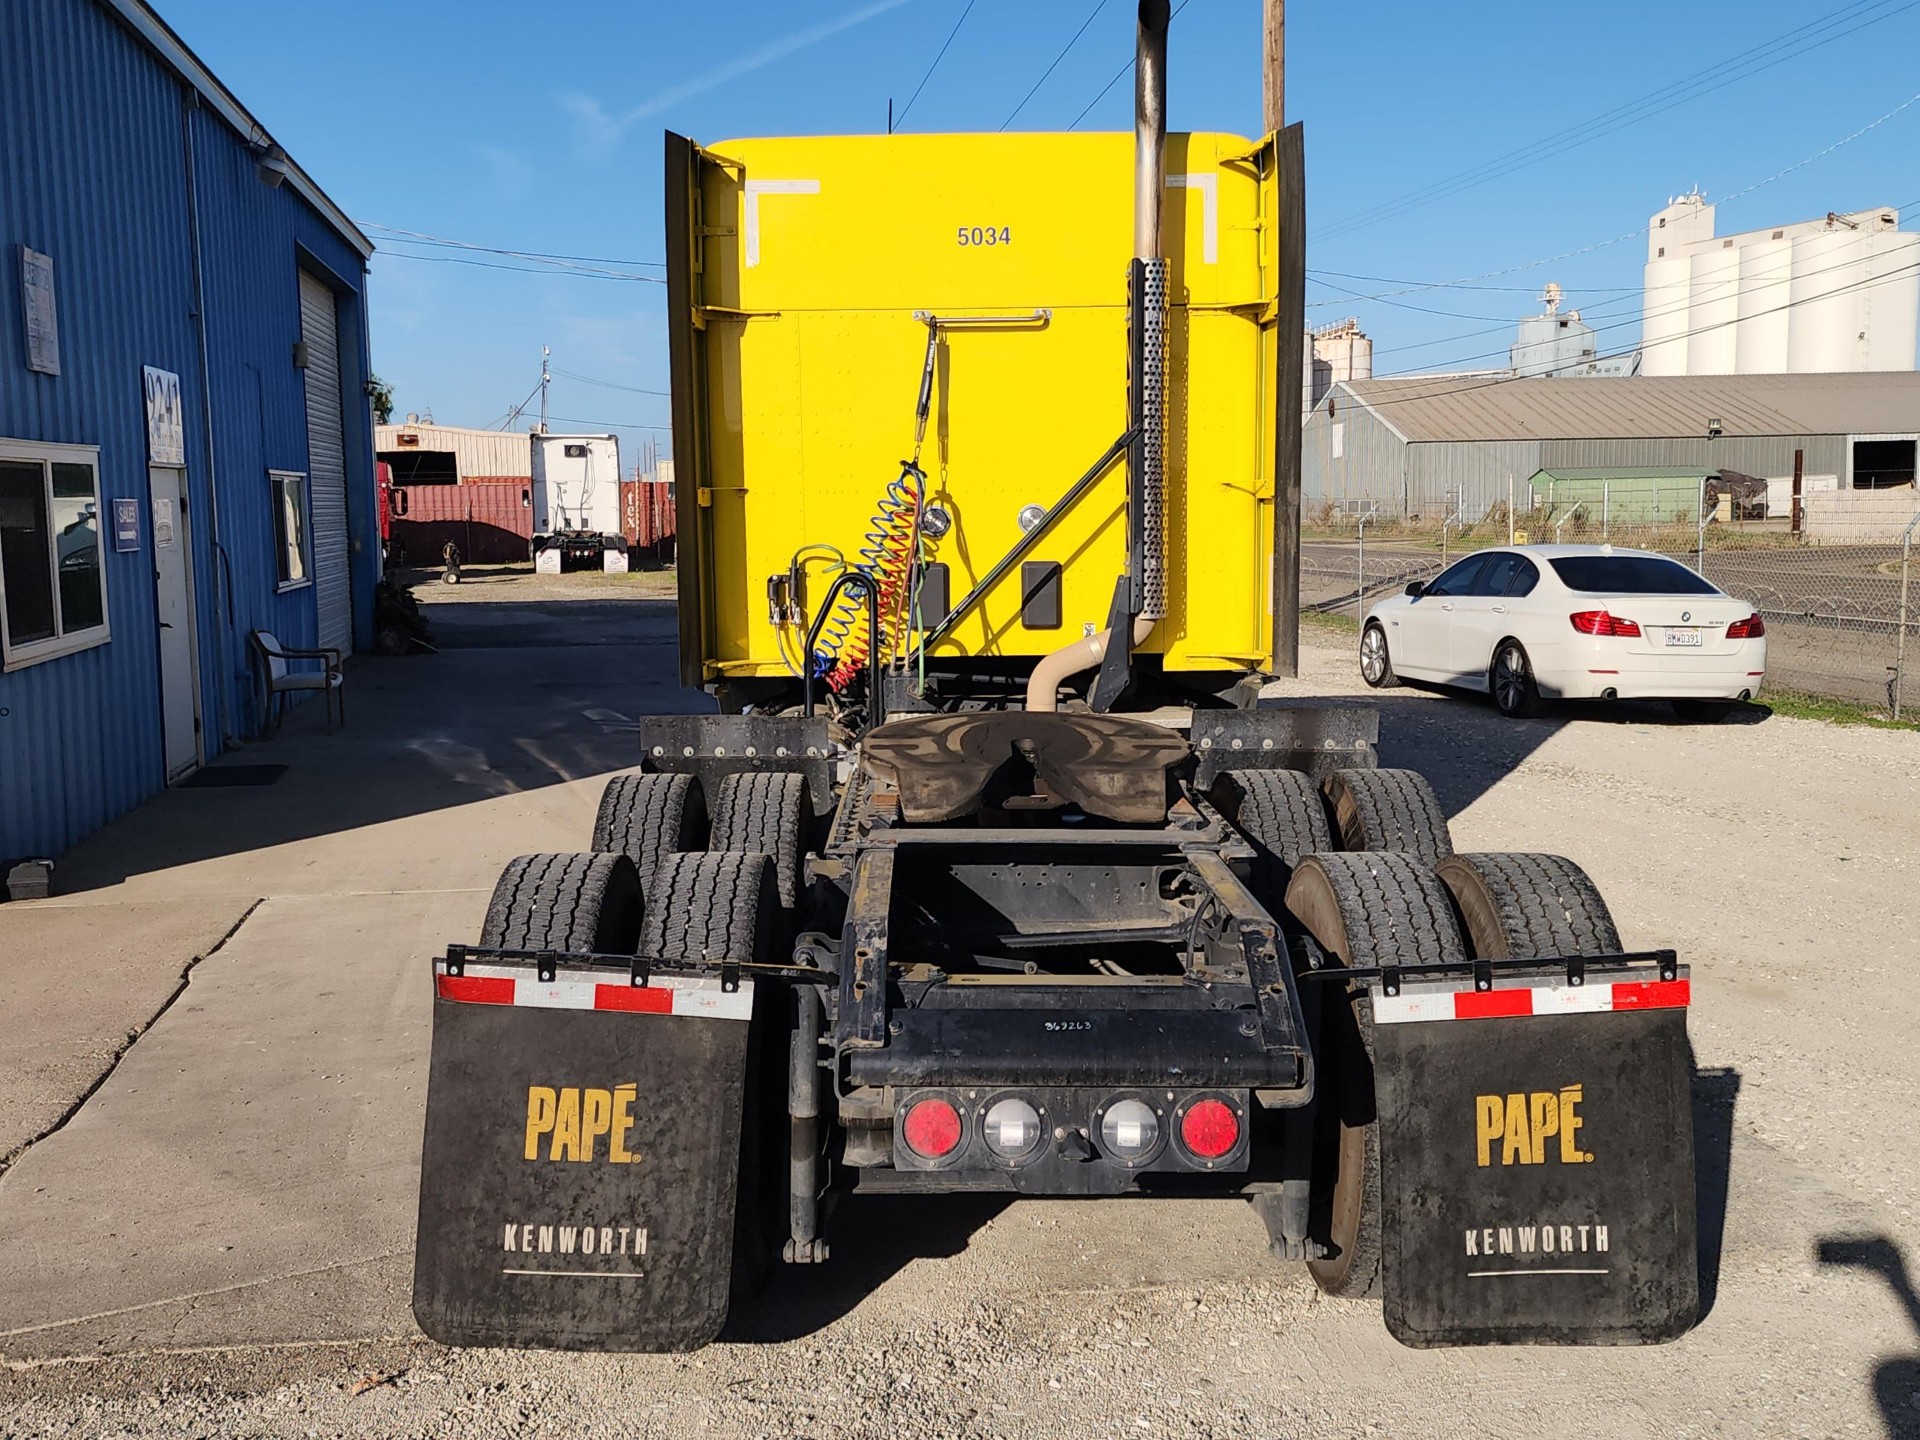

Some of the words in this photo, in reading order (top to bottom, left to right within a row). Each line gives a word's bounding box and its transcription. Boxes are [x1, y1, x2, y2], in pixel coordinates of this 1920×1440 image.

[957, 226, 1011, 246] 5034
[146, 372, 181, 426] 9241
[118, 506, 136, 523] SALES
[627, 491, 635, 528] tex
[1667, 633, 1700, 644] 8MWD391
[524, 1082, 638, 1163] PAPÉ
[1475, 1083, 1585, 1167] PAPÉ
[503, 1223, 648, 1256] KENWORTH
[1464, 1225, 1610, 1256] KENWORTH
